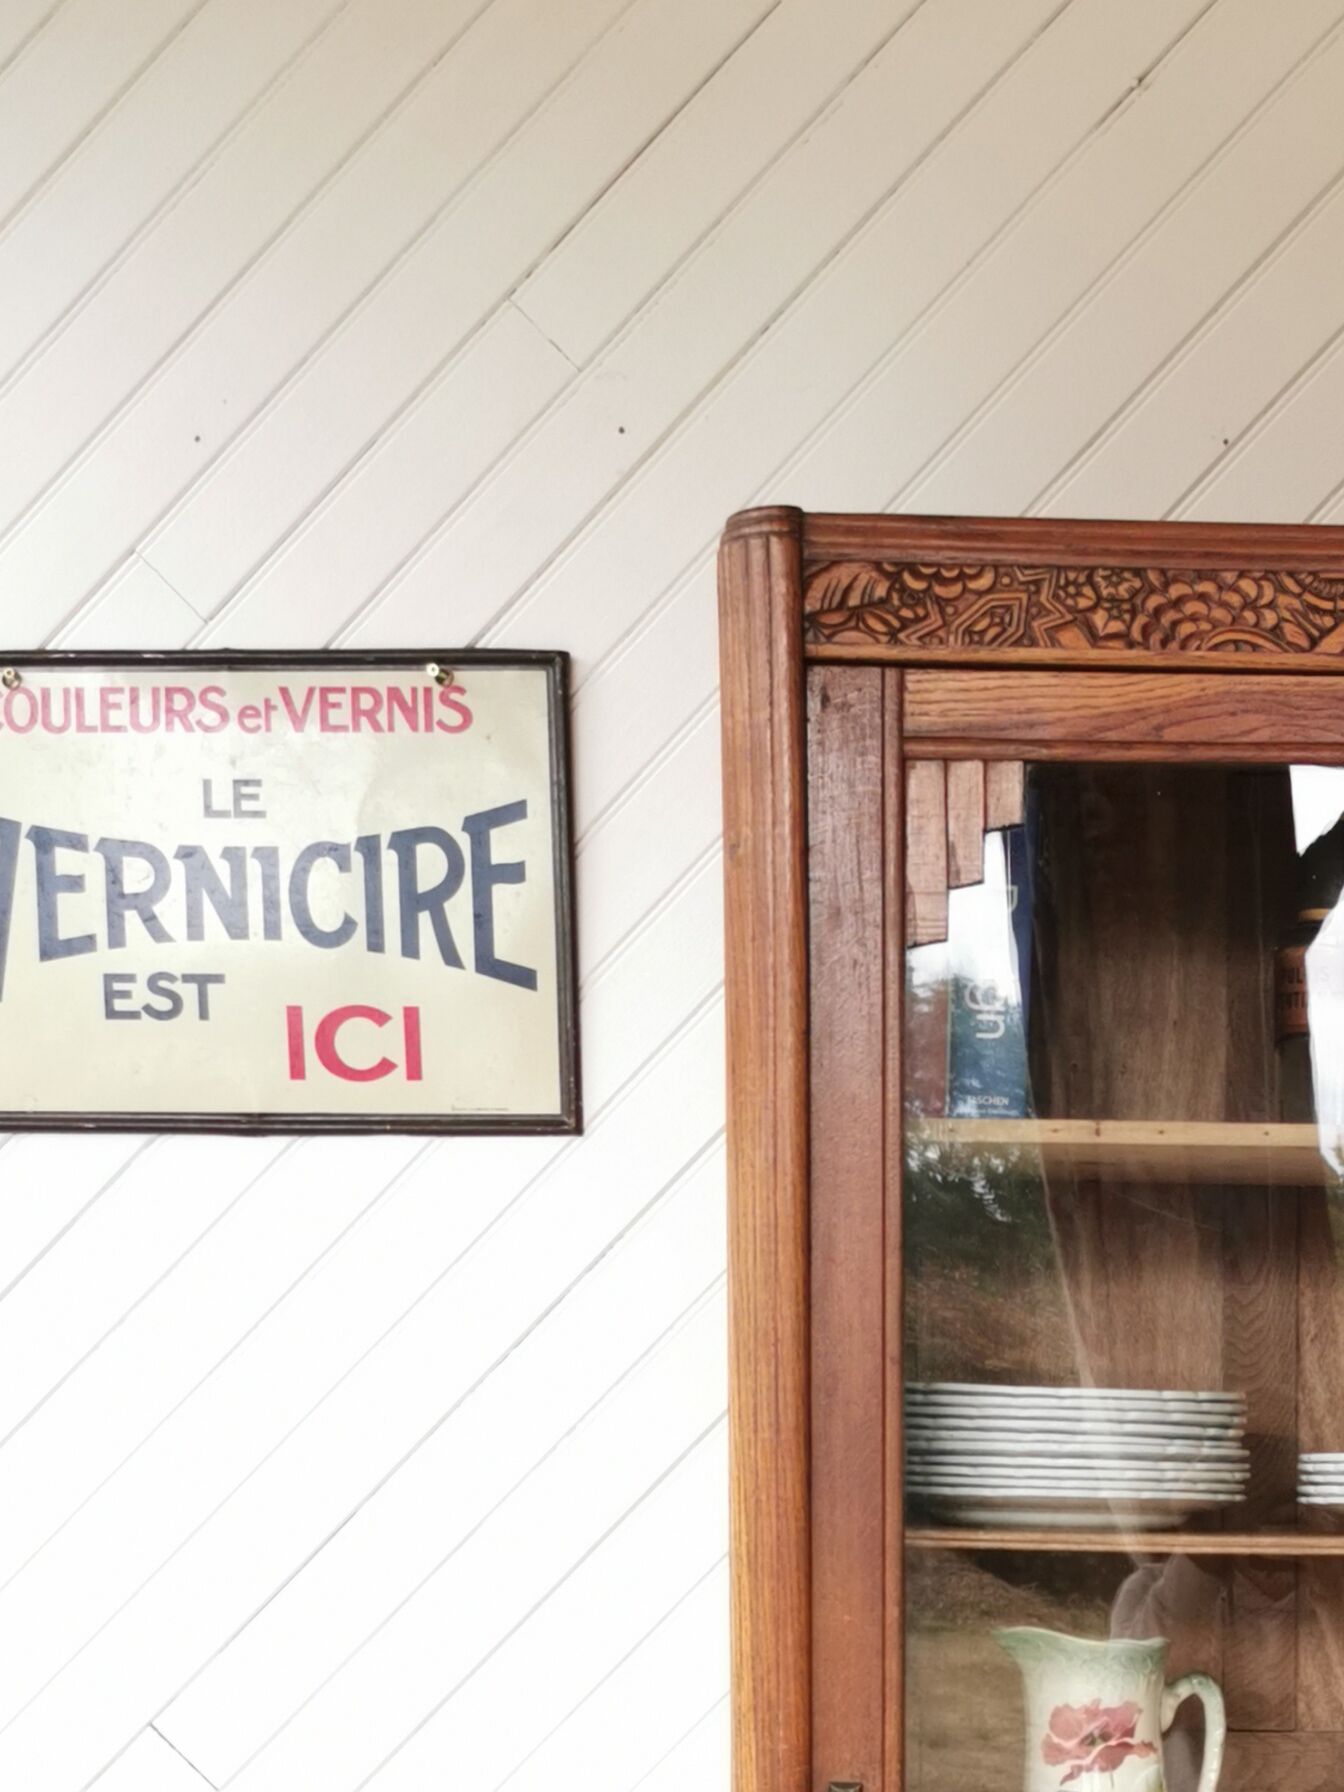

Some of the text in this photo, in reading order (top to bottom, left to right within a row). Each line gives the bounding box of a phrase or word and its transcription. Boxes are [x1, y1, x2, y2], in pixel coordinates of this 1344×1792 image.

[0, 684, 473, 734] OULEURS et VERNIS
[202, 779, 267, 819] LE
[103, 972, 225, 1021] EST
[286, 1005, 423, 1083] ICI
